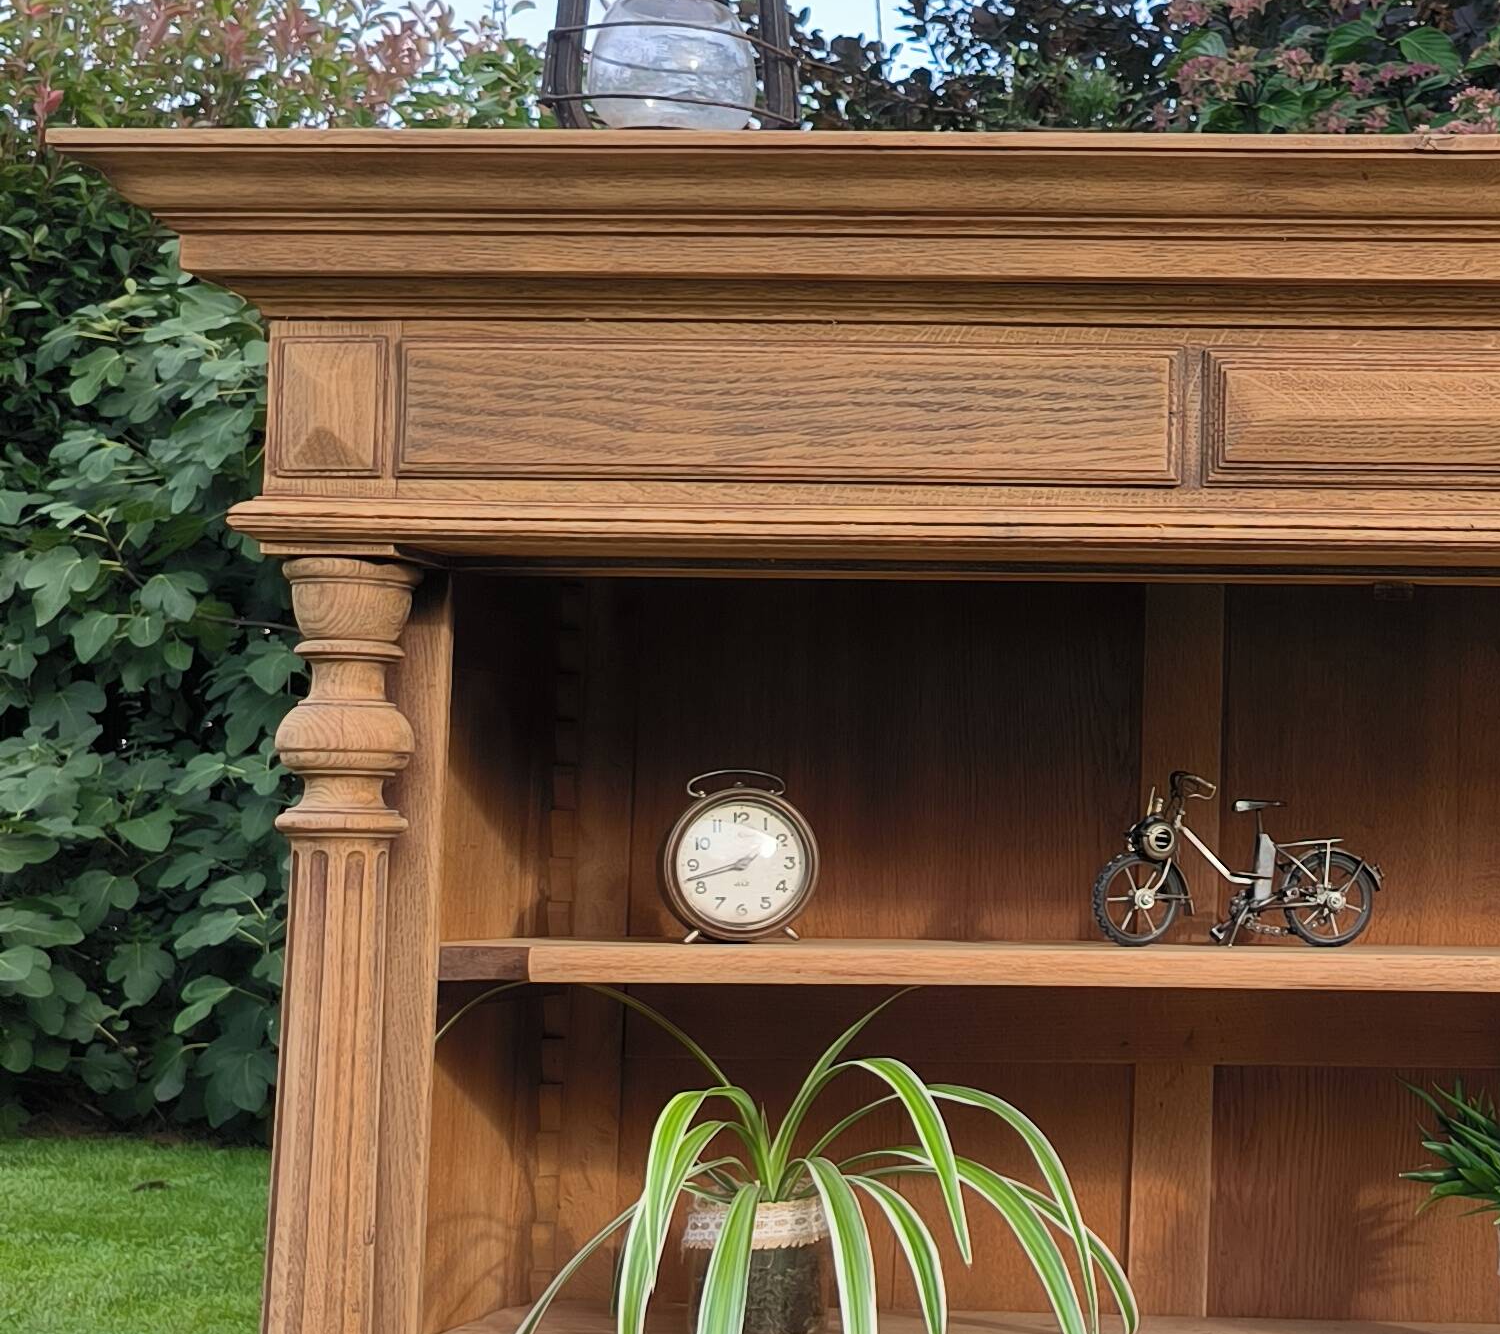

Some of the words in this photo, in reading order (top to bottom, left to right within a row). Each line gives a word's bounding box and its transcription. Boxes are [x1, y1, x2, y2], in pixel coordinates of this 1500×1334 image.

[733, 812, 750, 823] 12
[695, 836, 711, 851] 10
[687, 858, 700, 872] 9
[783, 856, 796, 870] 3
[695, 880, 707, 895] 8
[775, 879, 788, 893] 4
[714, 896, 727, 909] 7
[760, 896, 772, 910] 5
[736, 903, 748, 917] 6
